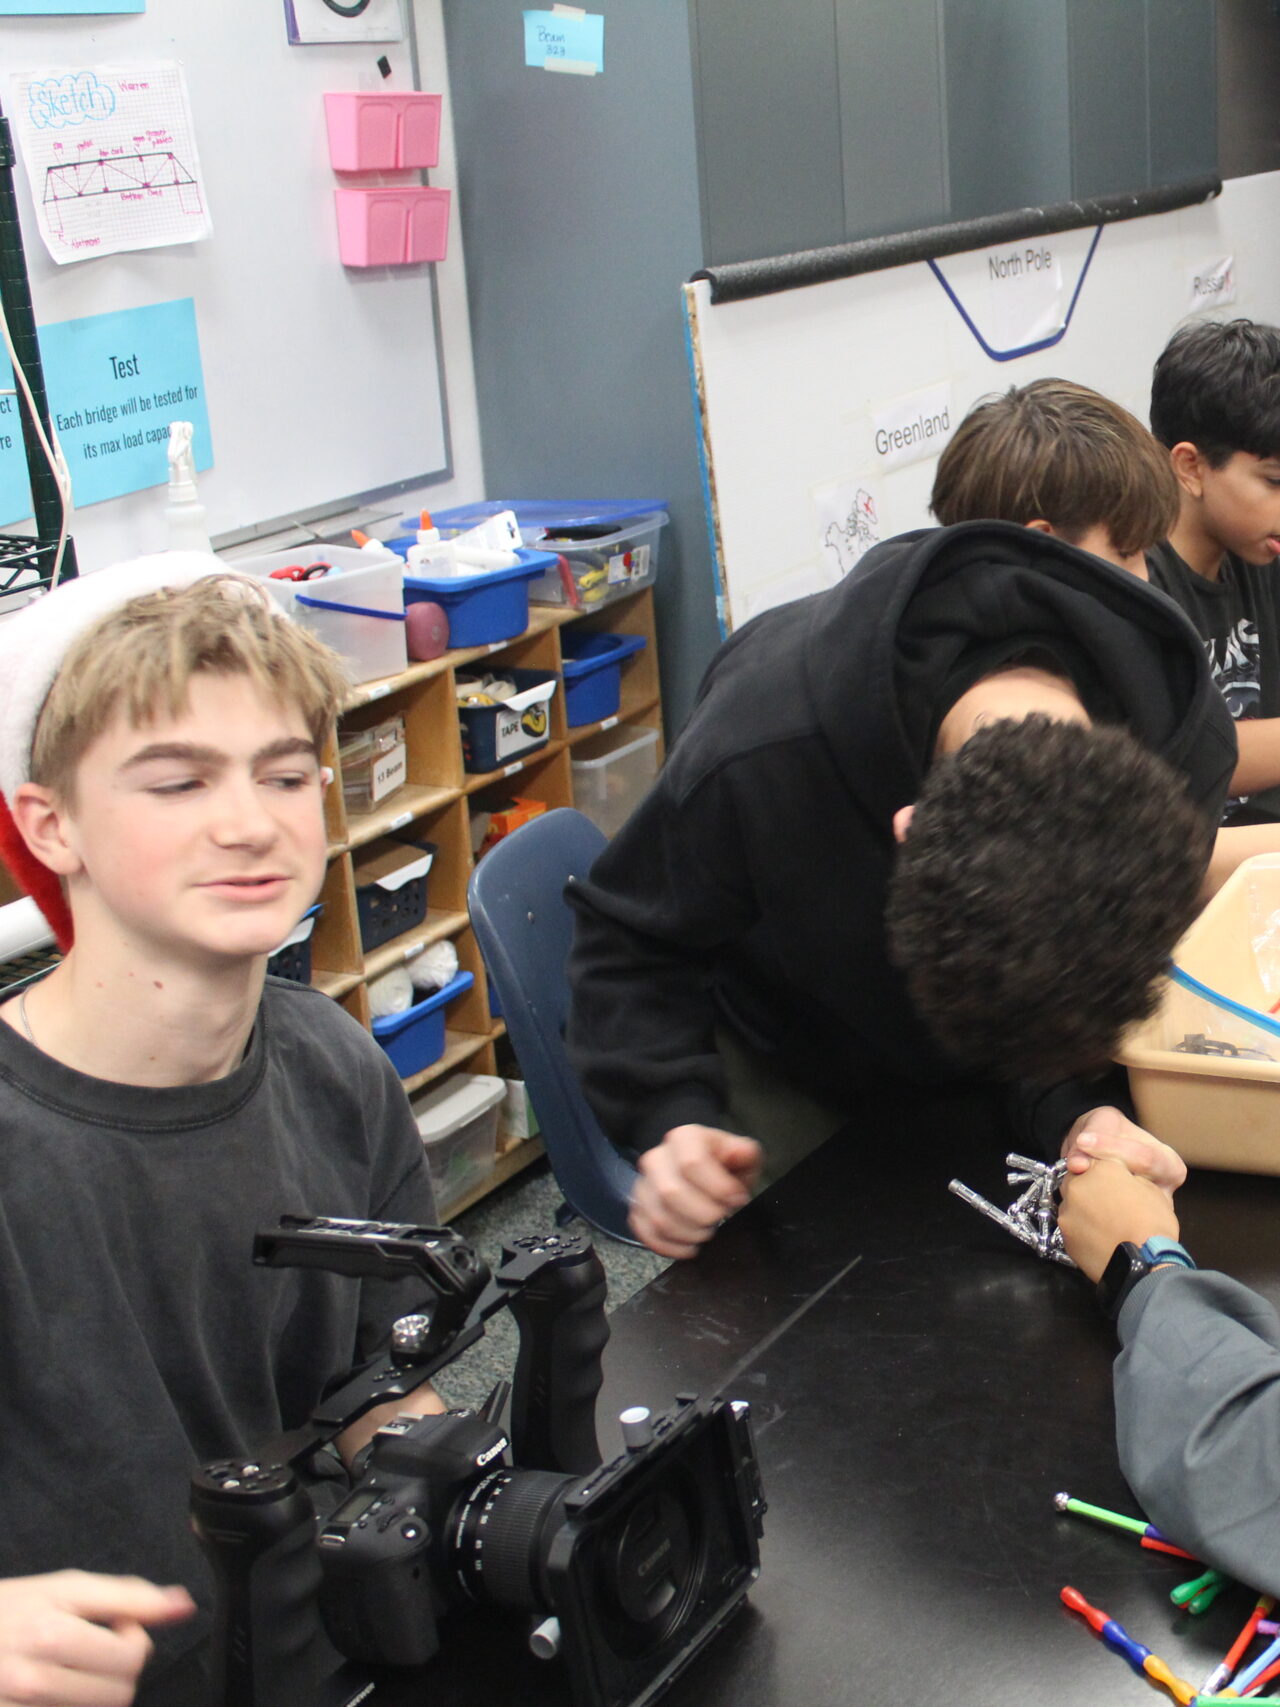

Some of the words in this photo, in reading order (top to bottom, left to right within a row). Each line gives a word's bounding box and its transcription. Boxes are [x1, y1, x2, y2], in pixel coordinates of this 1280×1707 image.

[37, 80, 107, 118] Sketch
[988, 255, 1023, 281] North
[1025, 247, 1052, 272] Pole
[109, 354, 140, 380] Test
[56, 411, 83, 432] Each
[85, 404, 118, 424] bridge
[120, 397, 138, 417] will
[139, 396, 152, 412] be
[153, 386, 183, 409] tested
[185, 385, 198, 401] for
[83, 443, 98, 460] its
[100, 439, 121, 456] max
[122, 429, 144, 449] load
[145, 425, 172, 445] capac
[875, 406, 950, 455] Greenland
[501, 720, 519, 738] TAPE
[476, 1437, 508, 1466] Canon
